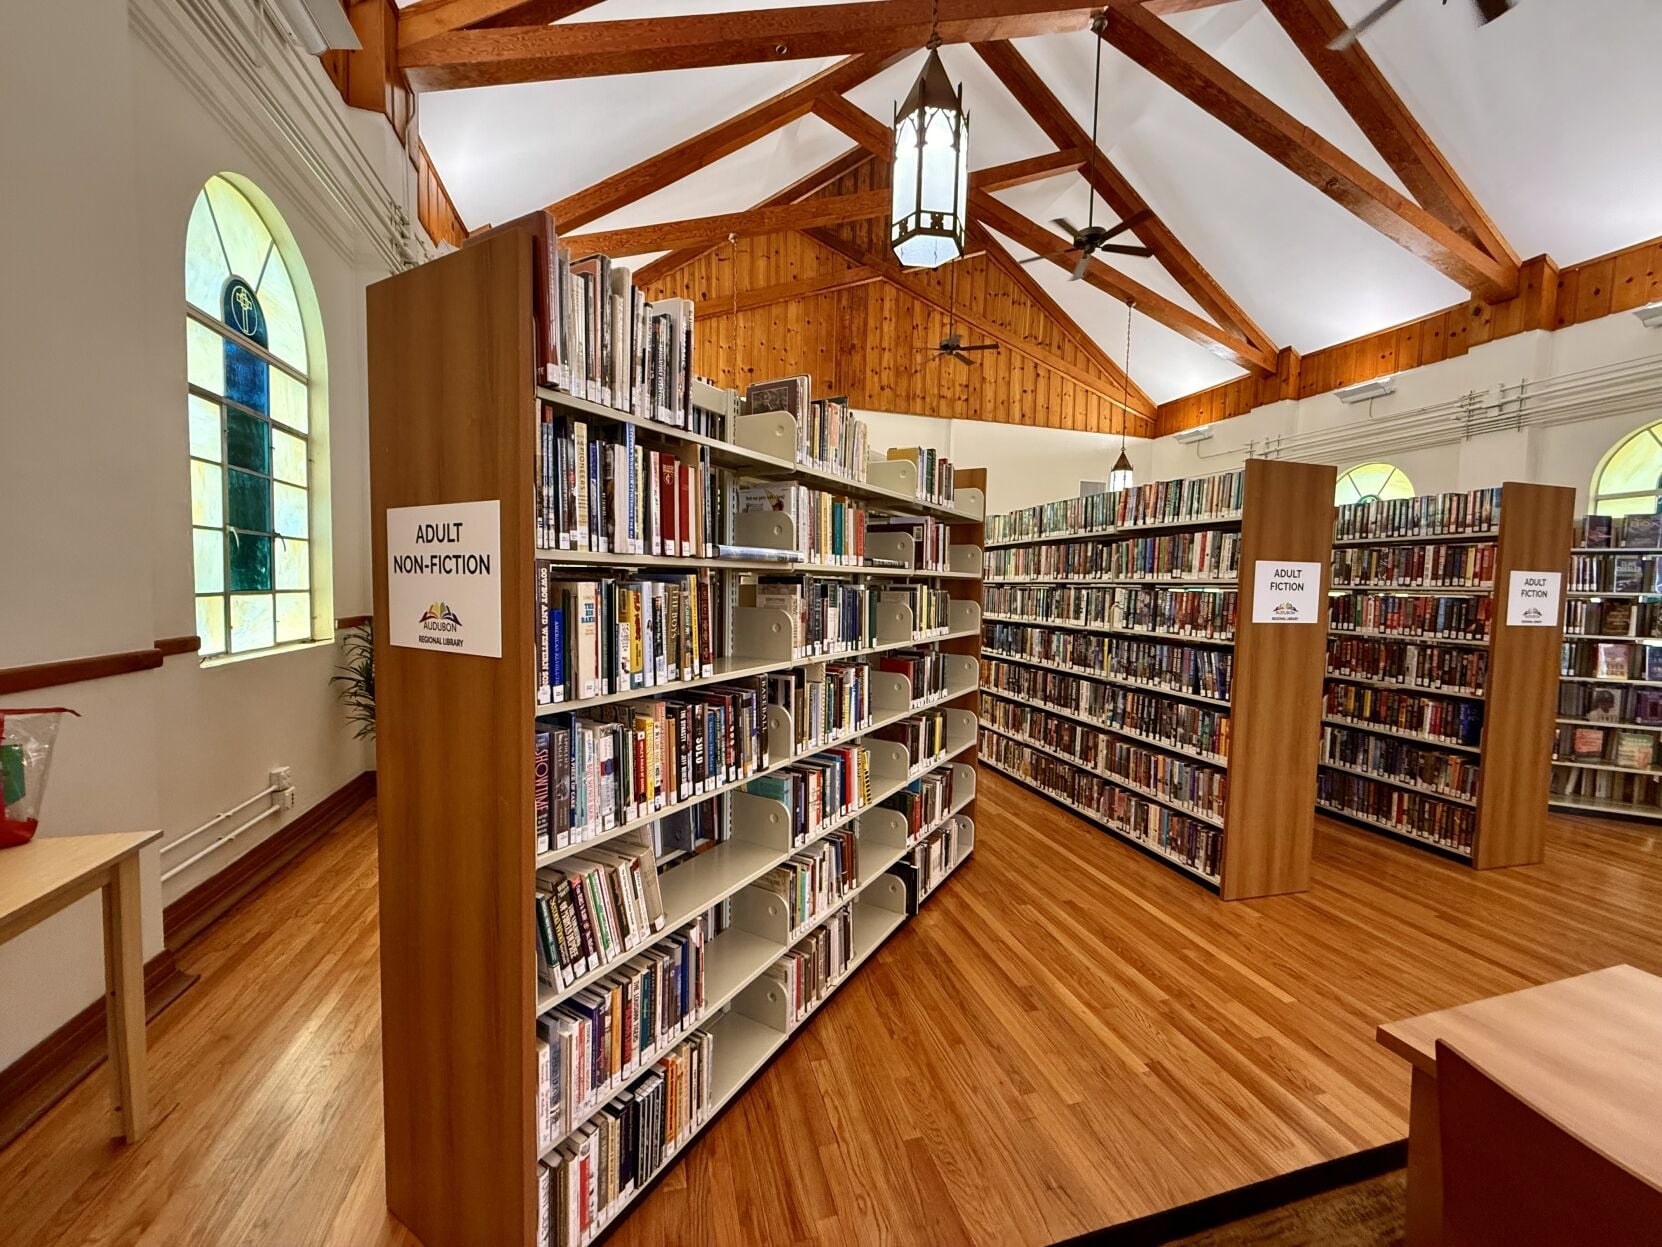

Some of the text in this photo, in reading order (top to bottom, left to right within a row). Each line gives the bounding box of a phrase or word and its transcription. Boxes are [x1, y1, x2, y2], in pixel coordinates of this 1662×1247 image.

[416, 522, 463, 544] ADULT
[394, 554, 490, 575] NON-FICTION
[1274, 569, 1302, 578] ADULT
[1270, 582, 1304, 591] FICTION
[423, 621, 457, 633] AUDUBON
[418, 635, 464, 647] REGIONAL LIBRARY
[535, 749, 548, 812] SHOWTIME
[571, 782, 575, 790] OF
